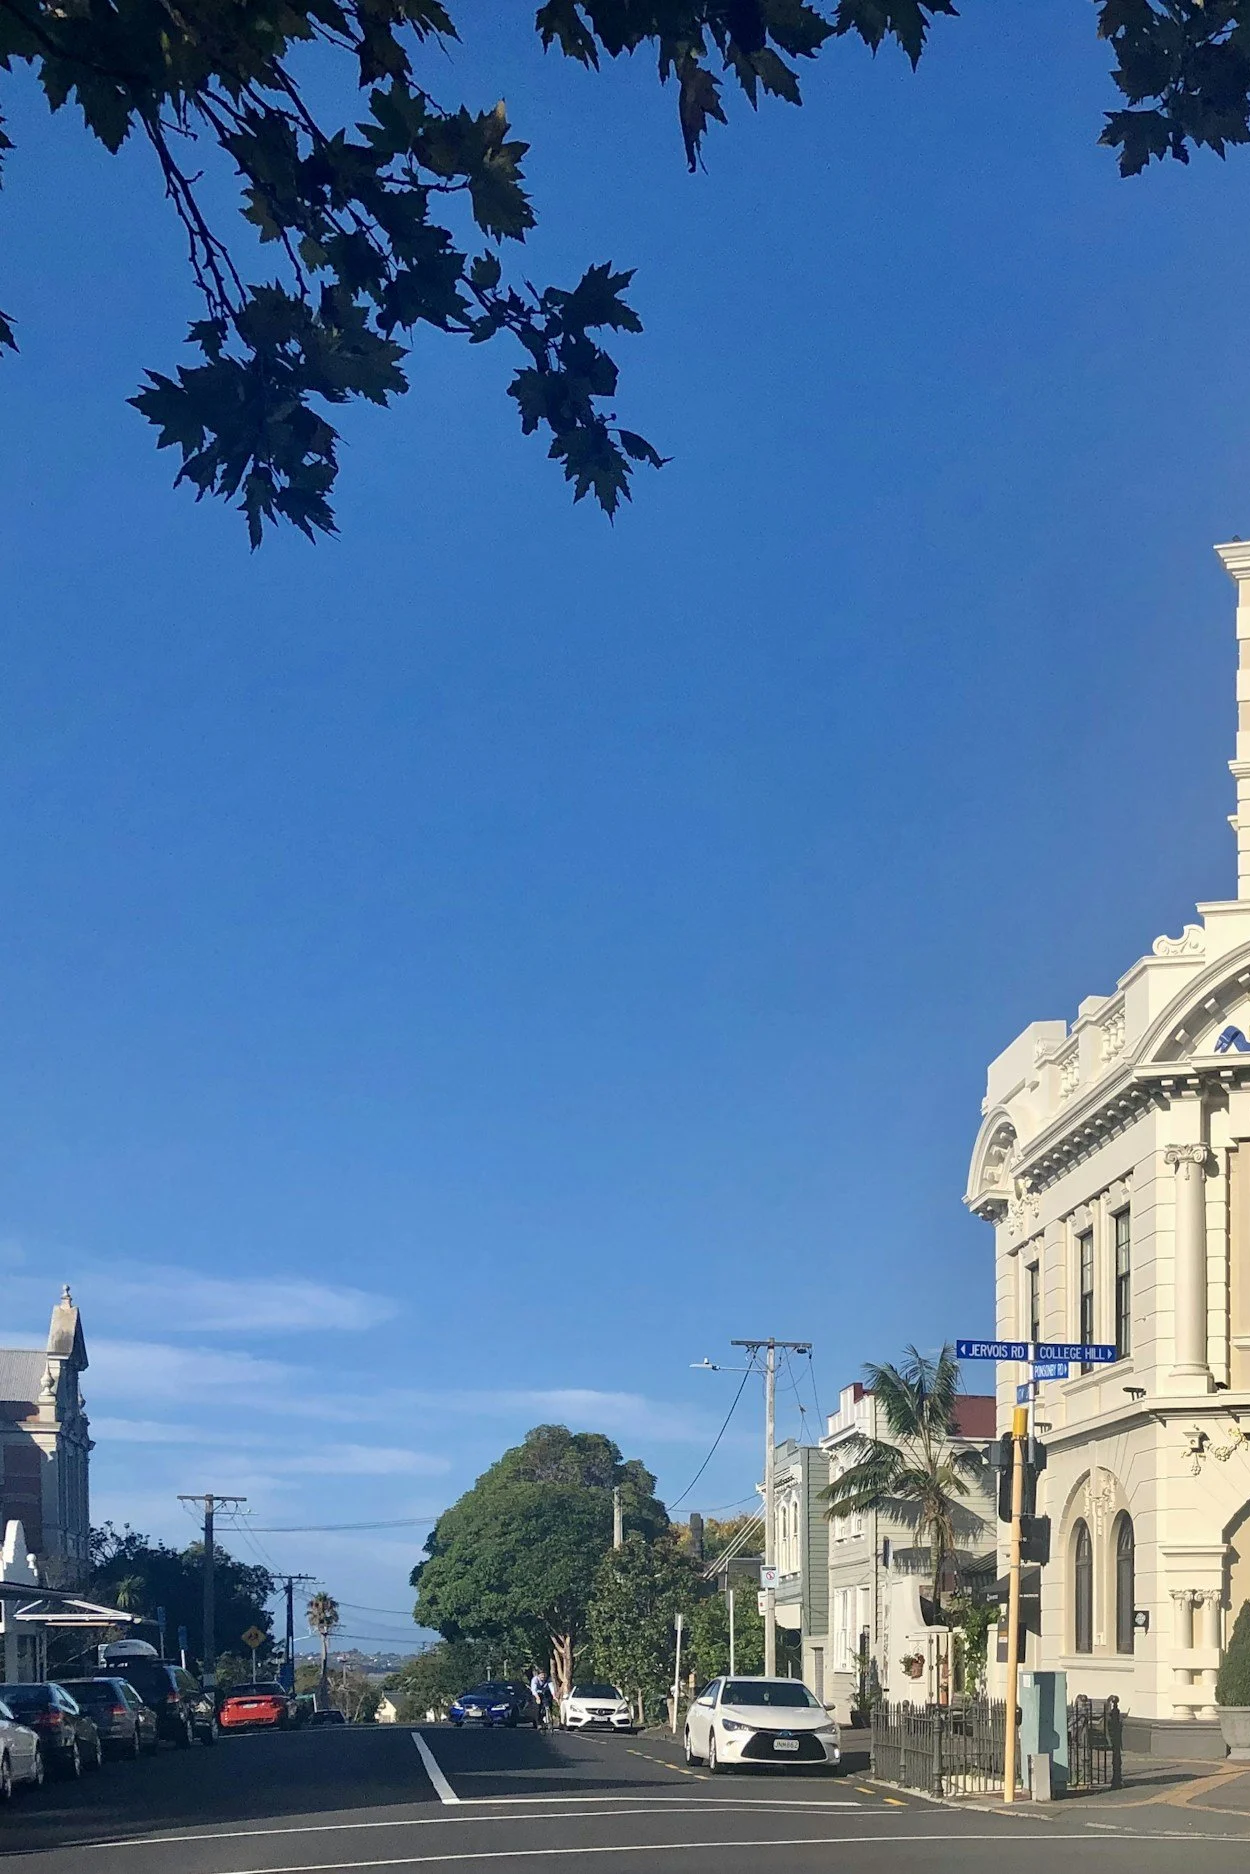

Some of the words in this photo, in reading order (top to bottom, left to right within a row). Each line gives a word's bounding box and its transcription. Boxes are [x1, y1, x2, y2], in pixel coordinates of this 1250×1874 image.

[969, 1344, 1008, 1358] JERVOIS
[1012, 1346, 1025, 1358] RD
[1040, 1347, 1082, 1360] COLLEGE
[1085, 1348, 1105, 1360] HILL
[1034, 1364, 1057, 1378] PONSONBY
[1058, 1363, 1065, 1377] RD
